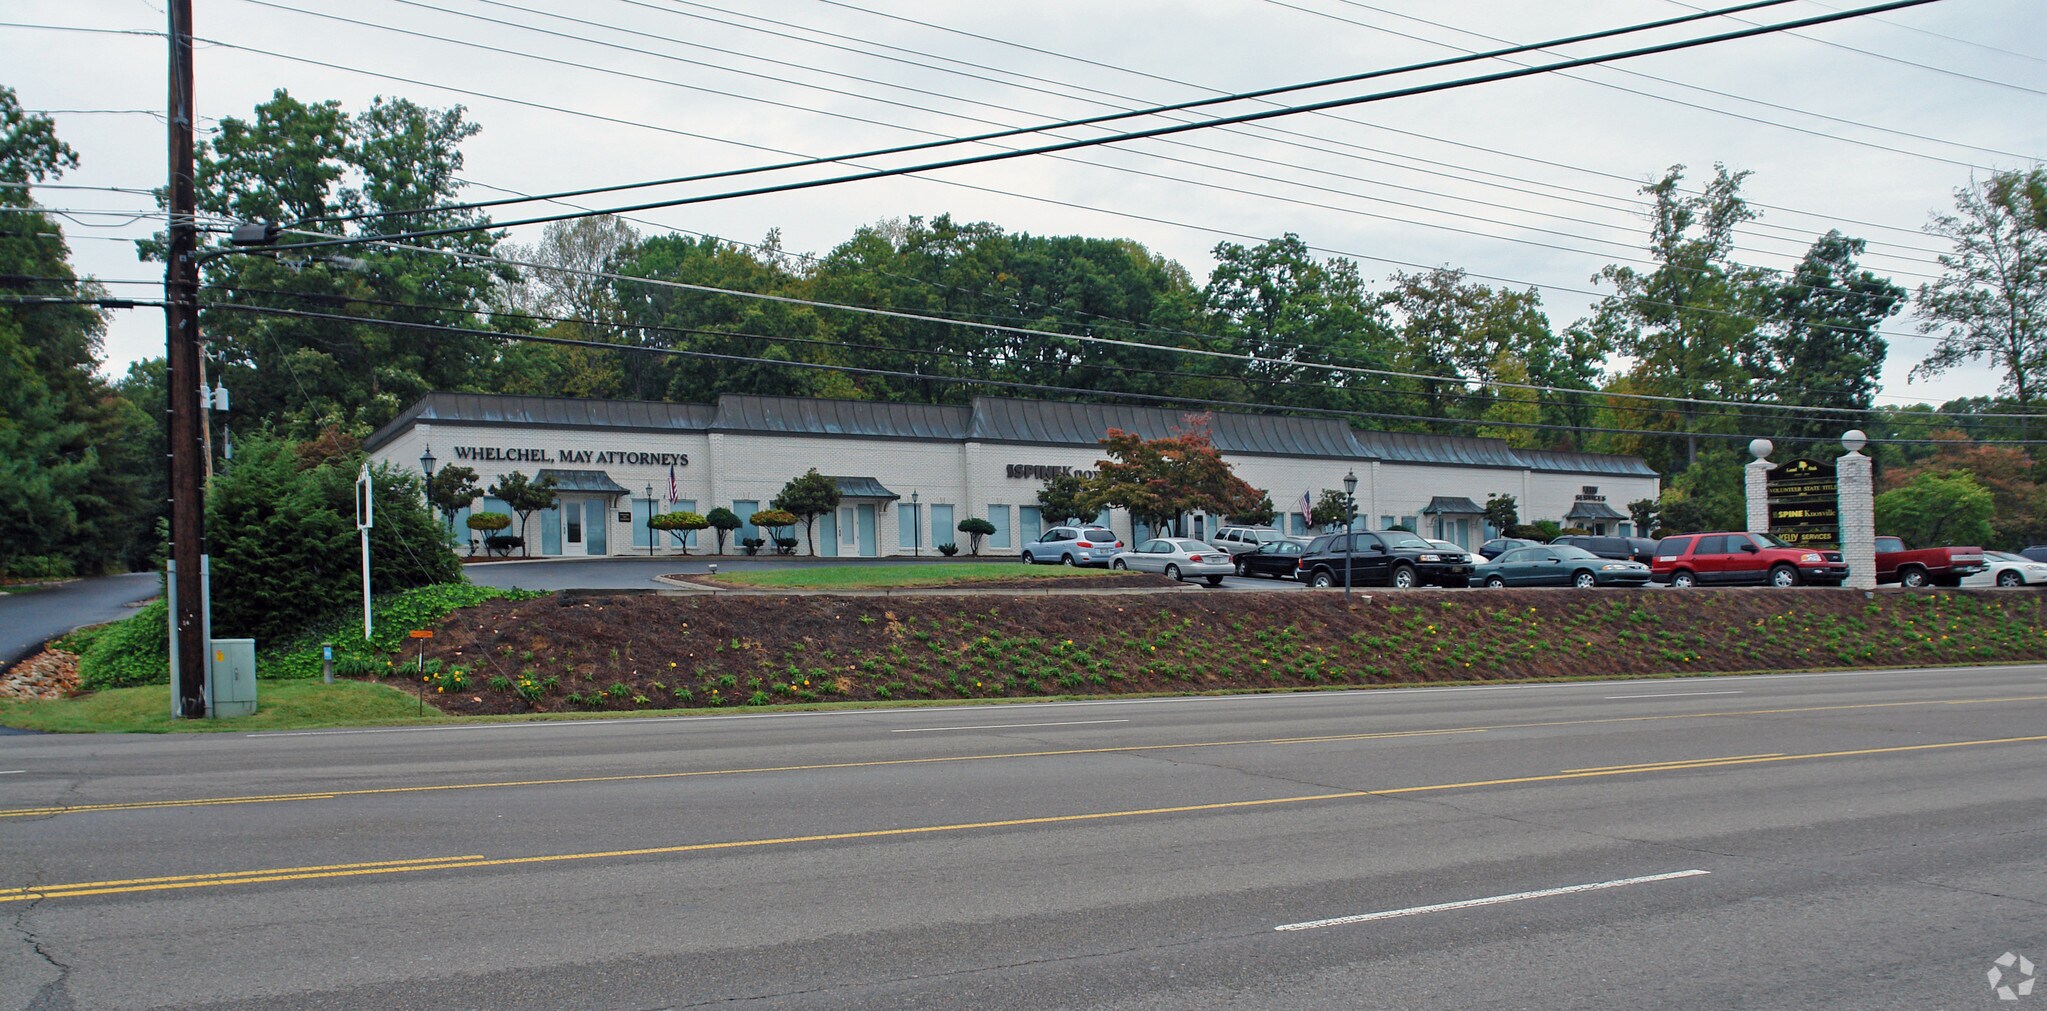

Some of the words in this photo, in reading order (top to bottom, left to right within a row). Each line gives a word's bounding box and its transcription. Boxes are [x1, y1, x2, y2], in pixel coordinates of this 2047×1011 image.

[454, 446, 554, 463] WHELCHEL,
[559, 449, 593, 463] MAY
[596, 451, 689, 466] ATTORNEYS
